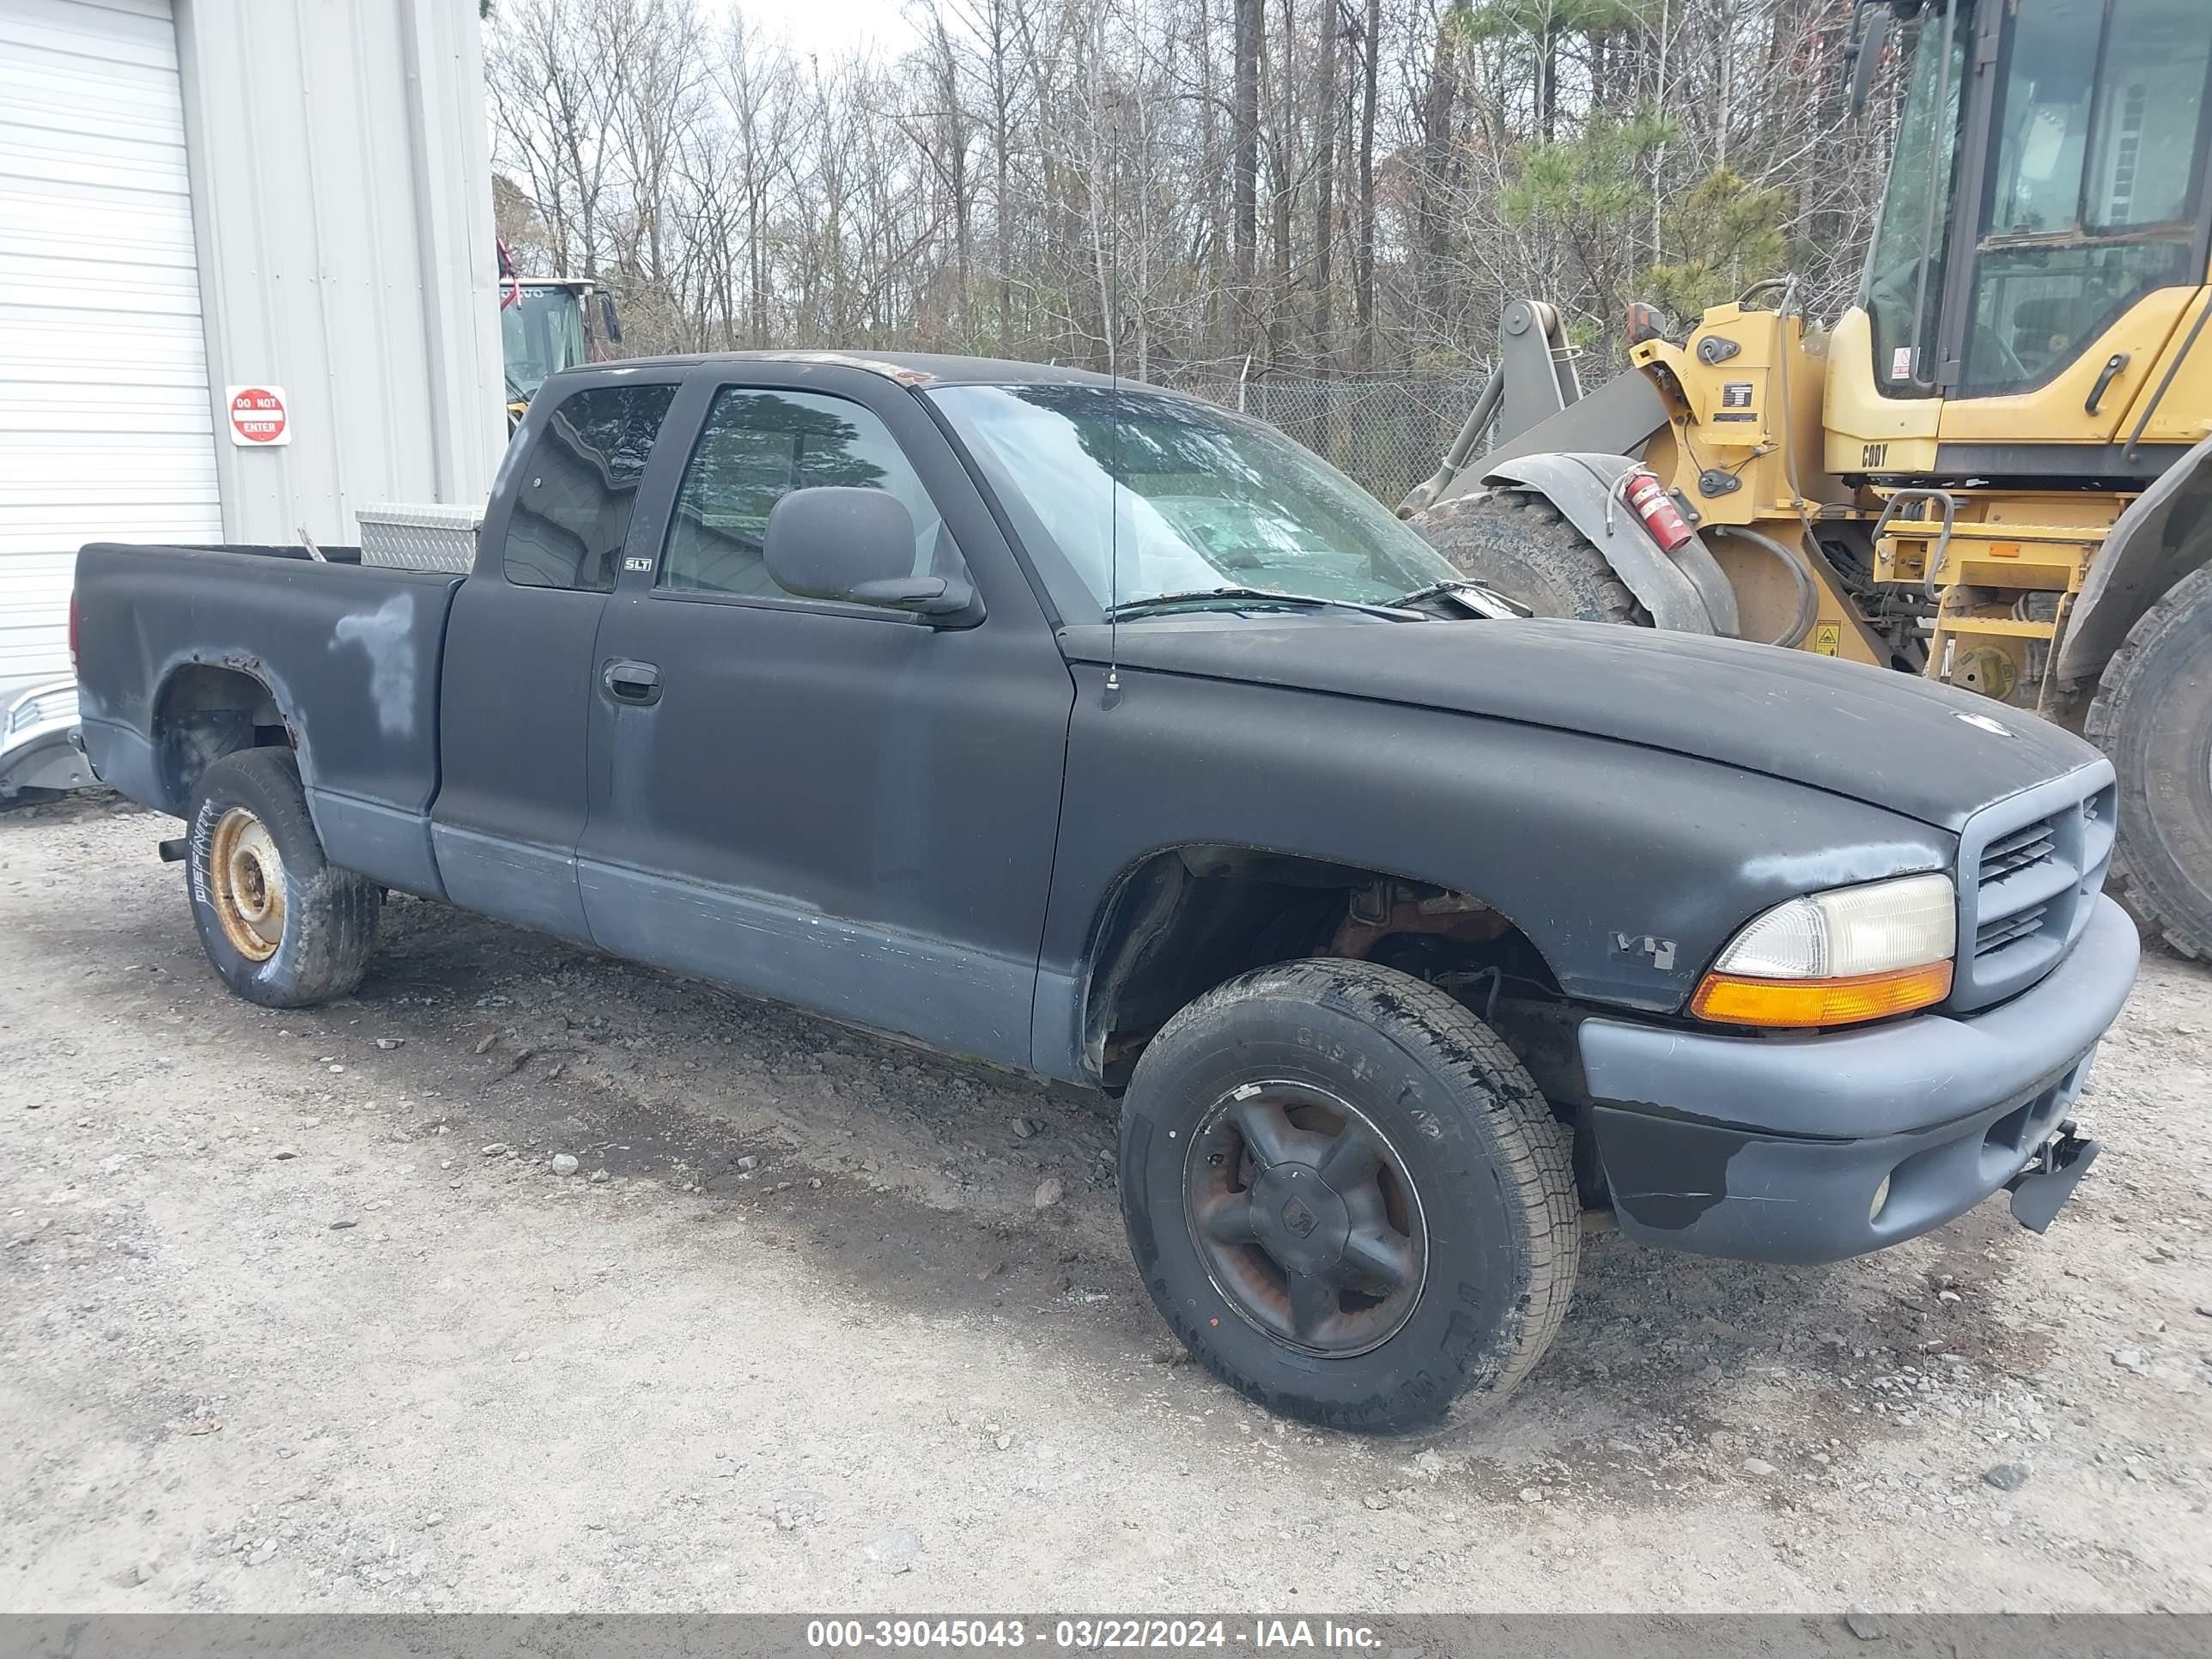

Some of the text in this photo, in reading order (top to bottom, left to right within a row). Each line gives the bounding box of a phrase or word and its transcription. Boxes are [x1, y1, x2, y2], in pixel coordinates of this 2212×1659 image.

[236, 398, 276, 408] DO NOT
[244, 422, 276, 433] ENTER
[1862, 443, 1888, 468] CODY
[625, 560, 650, 570] SLT
[190, 799, 213, 902] DEFINITY
